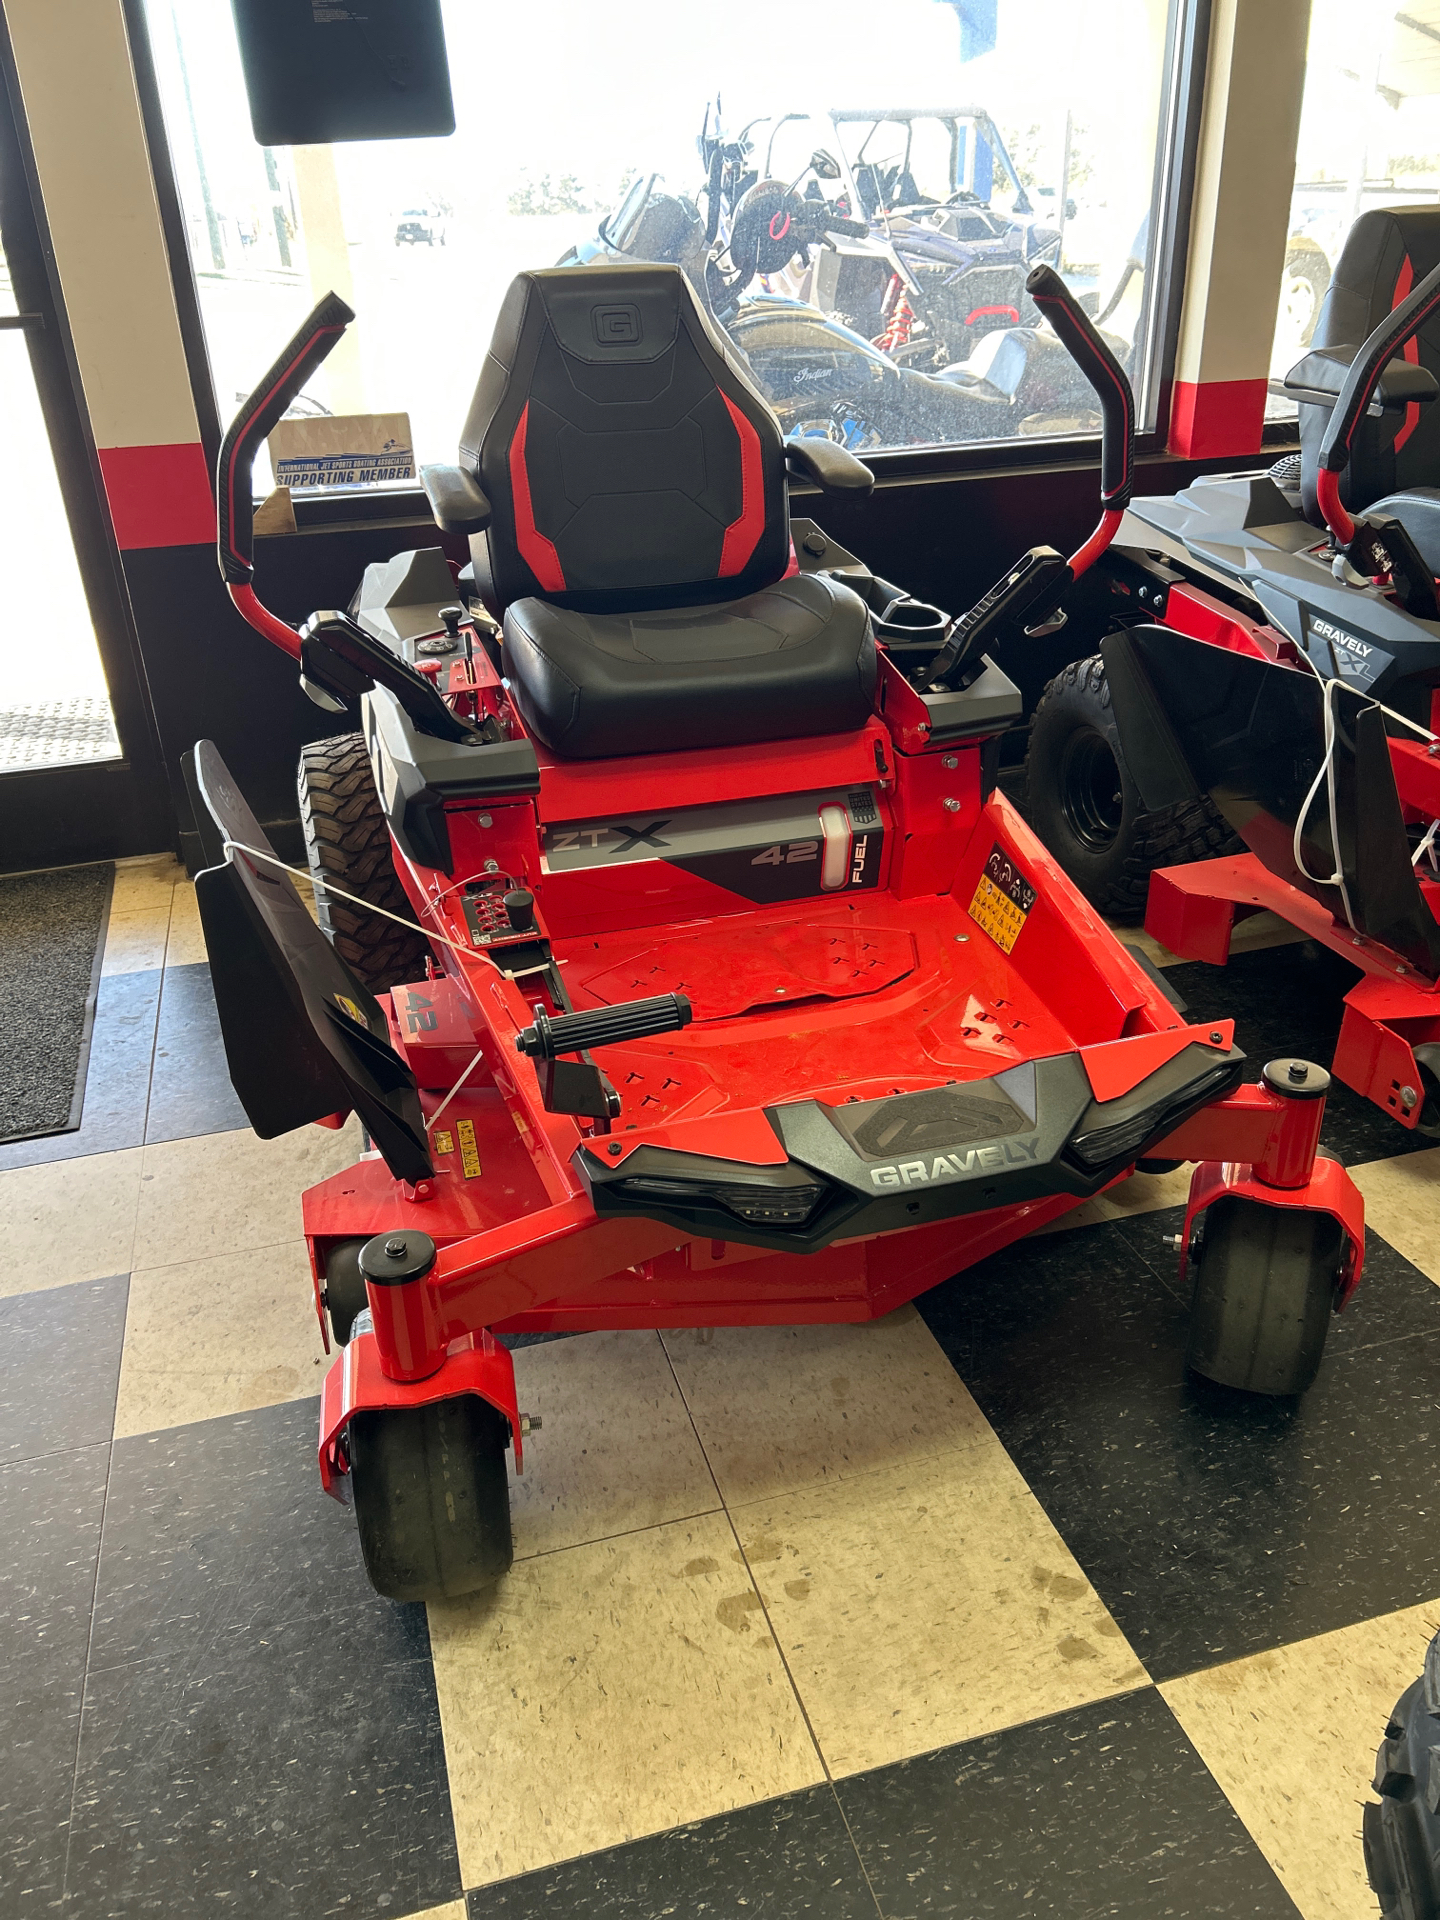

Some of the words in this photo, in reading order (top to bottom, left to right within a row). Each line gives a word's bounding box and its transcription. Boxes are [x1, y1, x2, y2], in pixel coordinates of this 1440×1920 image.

[793, 367, 833, 386] Indian
[276, 470, 355, 487] SUPPORTING
[359, 467, 411, 482] MEMBER
[278, 464, 319, 473] INTERNATIONAL
[320, 462, 331, 470] JET
[332, 460, 353, 469] SPORTS
[353, 458, 377, 468] BOATING
[377, 456, 412, 467] ASSOCIATION
[1313, 619, 1374, 658] GRAVELY
[751, 841, 819, 866] 42
[852, 834, 868, 883] FUEL
[405, 992, 439, 1034] 42
[870, 1137, 1040, 1189] GRAVELY
